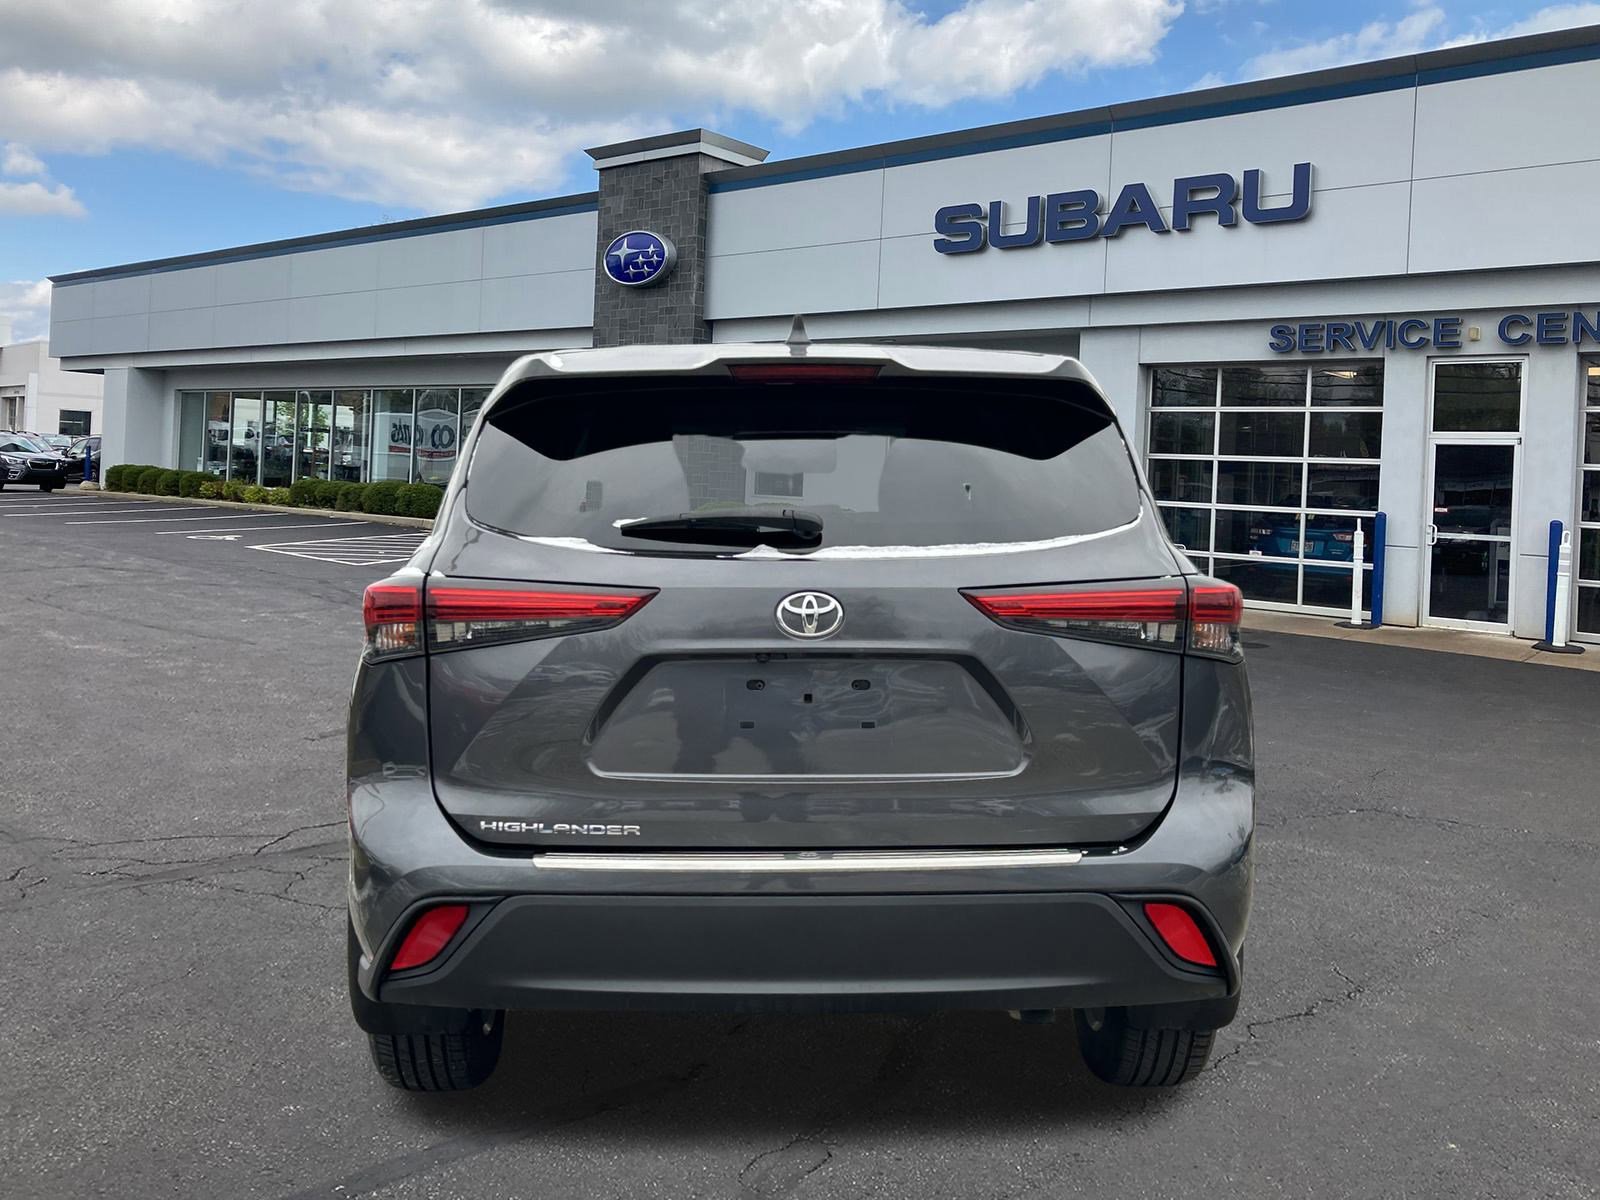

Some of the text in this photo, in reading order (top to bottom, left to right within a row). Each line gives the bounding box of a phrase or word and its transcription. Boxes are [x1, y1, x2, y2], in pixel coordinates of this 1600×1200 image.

[933, 162, 1313, 254] SUBARU
[1269, 311, 1600, 353] SERVICE CEN
[479, 820, 641, 836] HIGHLANDER
